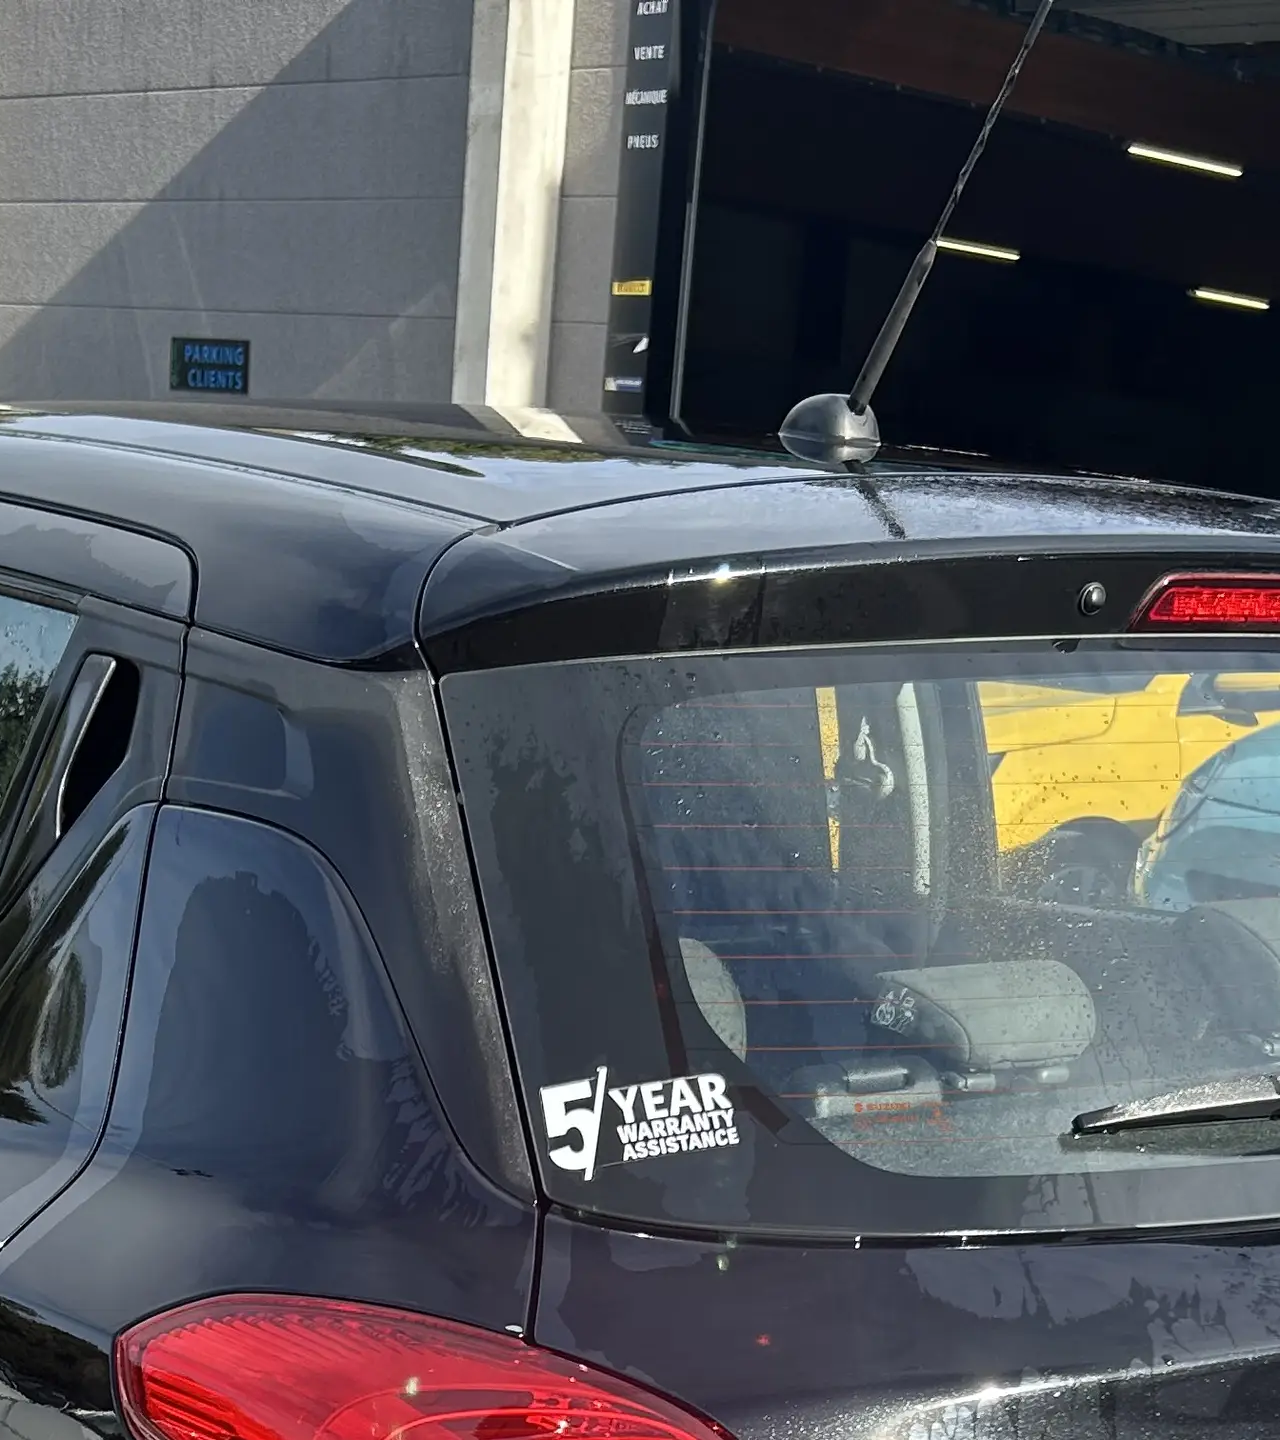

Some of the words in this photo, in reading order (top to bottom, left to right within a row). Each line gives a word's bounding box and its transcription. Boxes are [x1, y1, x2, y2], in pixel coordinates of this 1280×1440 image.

[634, 45, 666, 60] VENTE
[627, 134, 659, 149] PNEUS
[184, 344, 245, 367] PARKING
[187, 367, 243, 390] CLIENTS
[608, 1073, 733, 1125] YEAR
[616, 1108, 735, 1145] WARRANTY
[622, 1127, 741, 1163] ASSISTANCE
